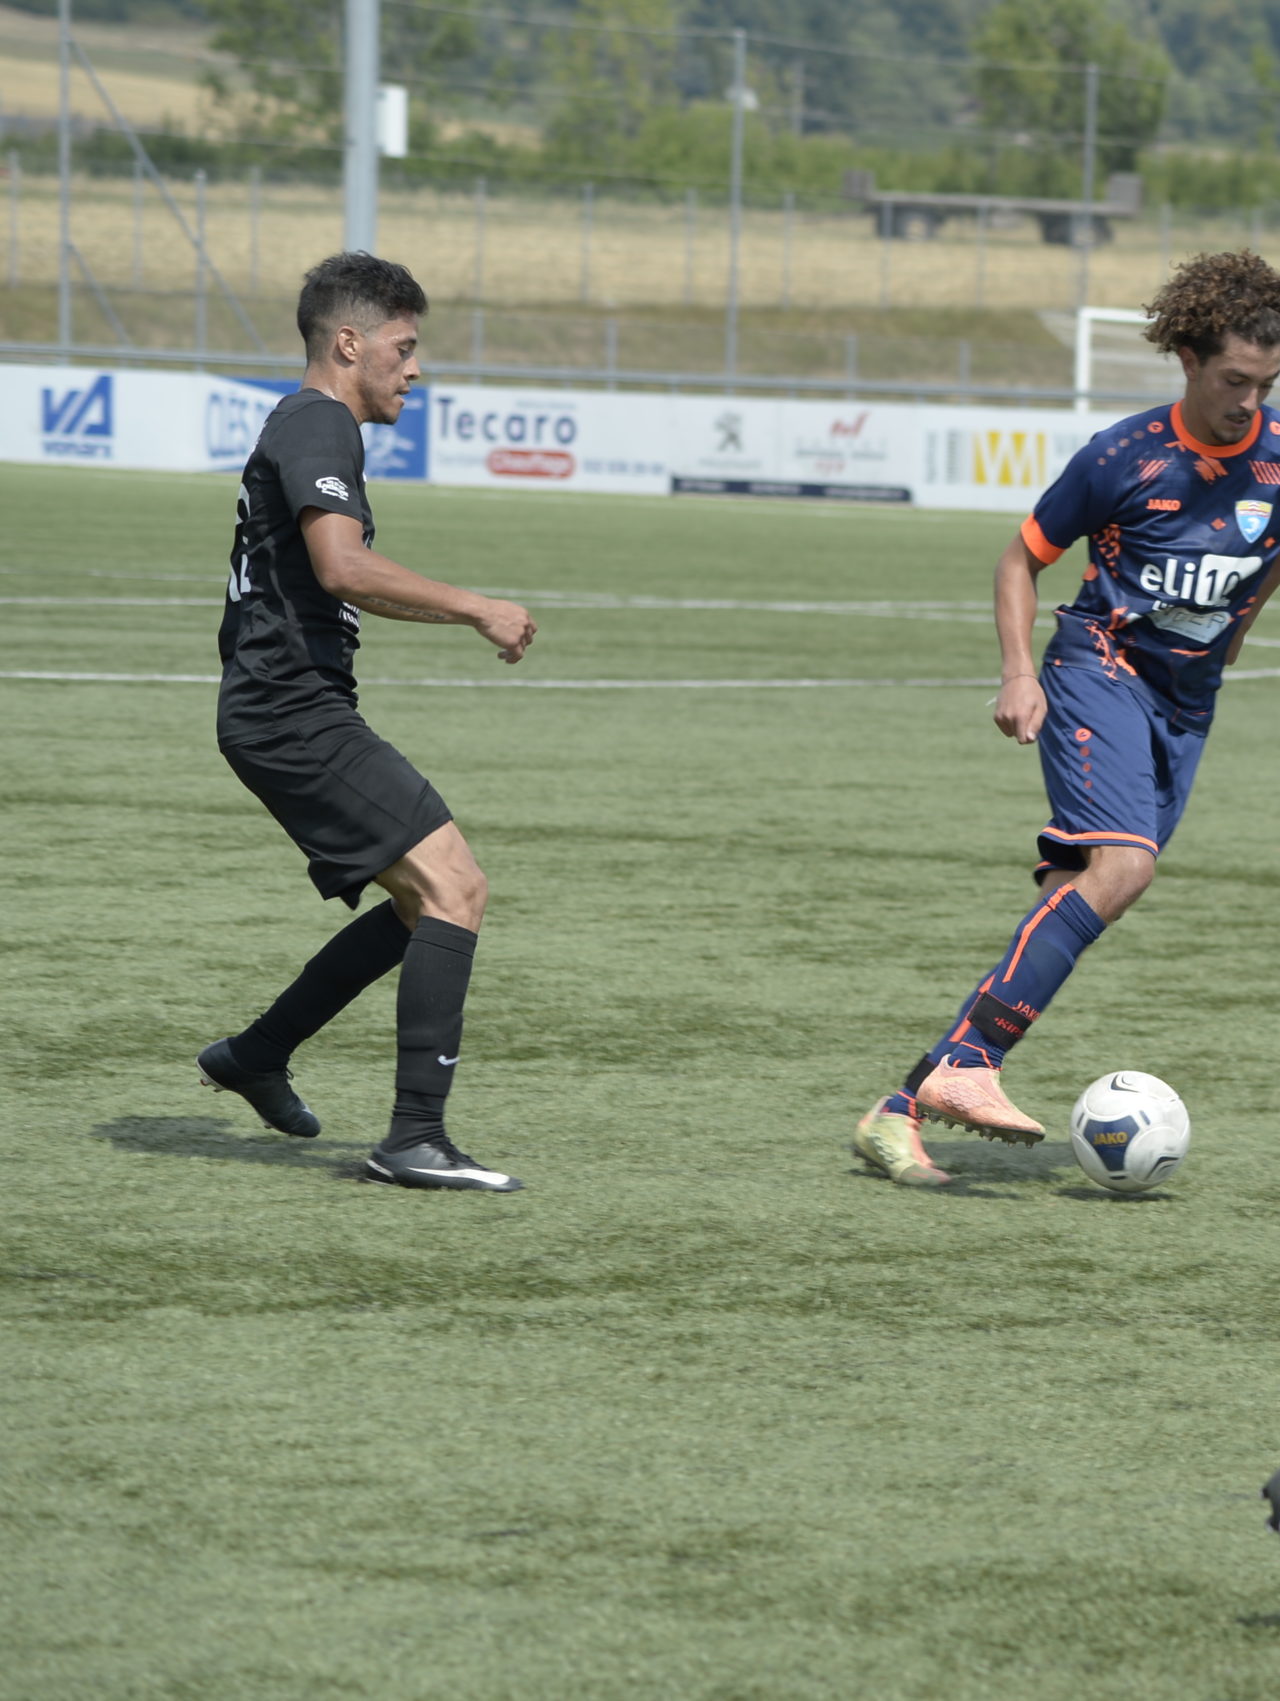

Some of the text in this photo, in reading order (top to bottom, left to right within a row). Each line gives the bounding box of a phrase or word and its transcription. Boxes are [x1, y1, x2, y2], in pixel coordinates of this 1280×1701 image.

[437, 397, 577, 445] Tecaro
[1146, 498, 1181, 511] JAKO
[1093, 1131, 1128, 1145] JAKO
